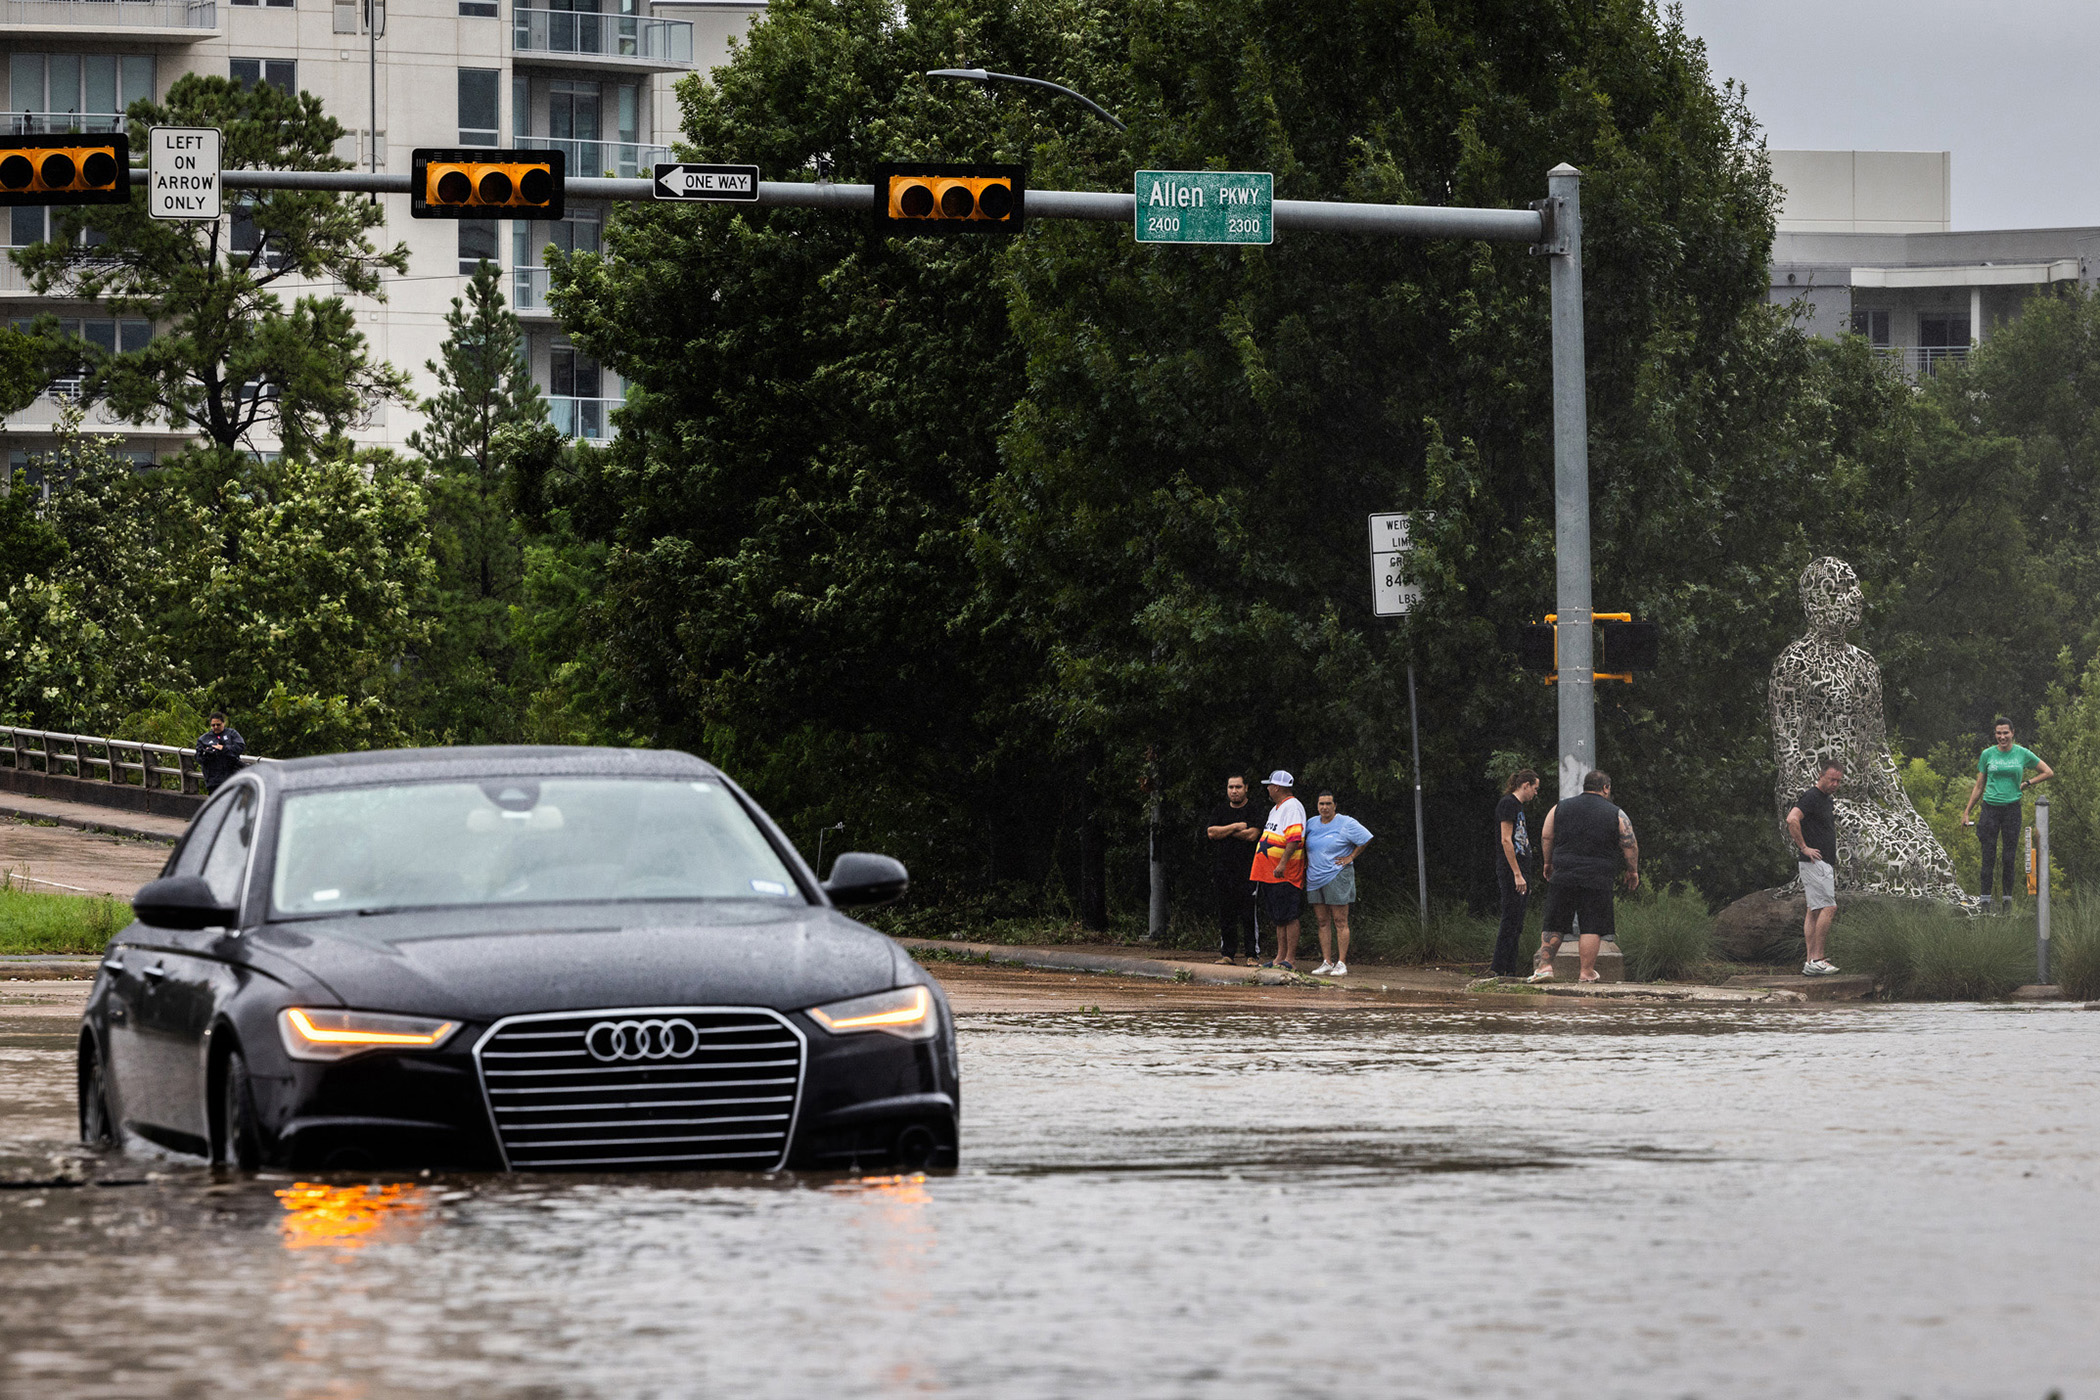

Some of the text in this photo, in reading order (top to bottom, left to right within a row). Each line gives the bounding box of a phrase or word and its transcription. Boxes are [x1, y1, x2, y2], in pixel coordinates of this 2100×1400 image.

[166, 136, 203, 149] LEFT
[175, 156, 195, 169] ON
[157, 176, 213, 190] ARROW
[685, 175, 747, 190] ONE WAY
[1149, 180, 1260, 207] Allen PKWY
[164, 196, 206, 210] ONLY
[1148, 217, 1260, 233] 2400 2300
[1386, 519, 1410, 530] WEIG
[1398, 594, 1417, 604] LBS
